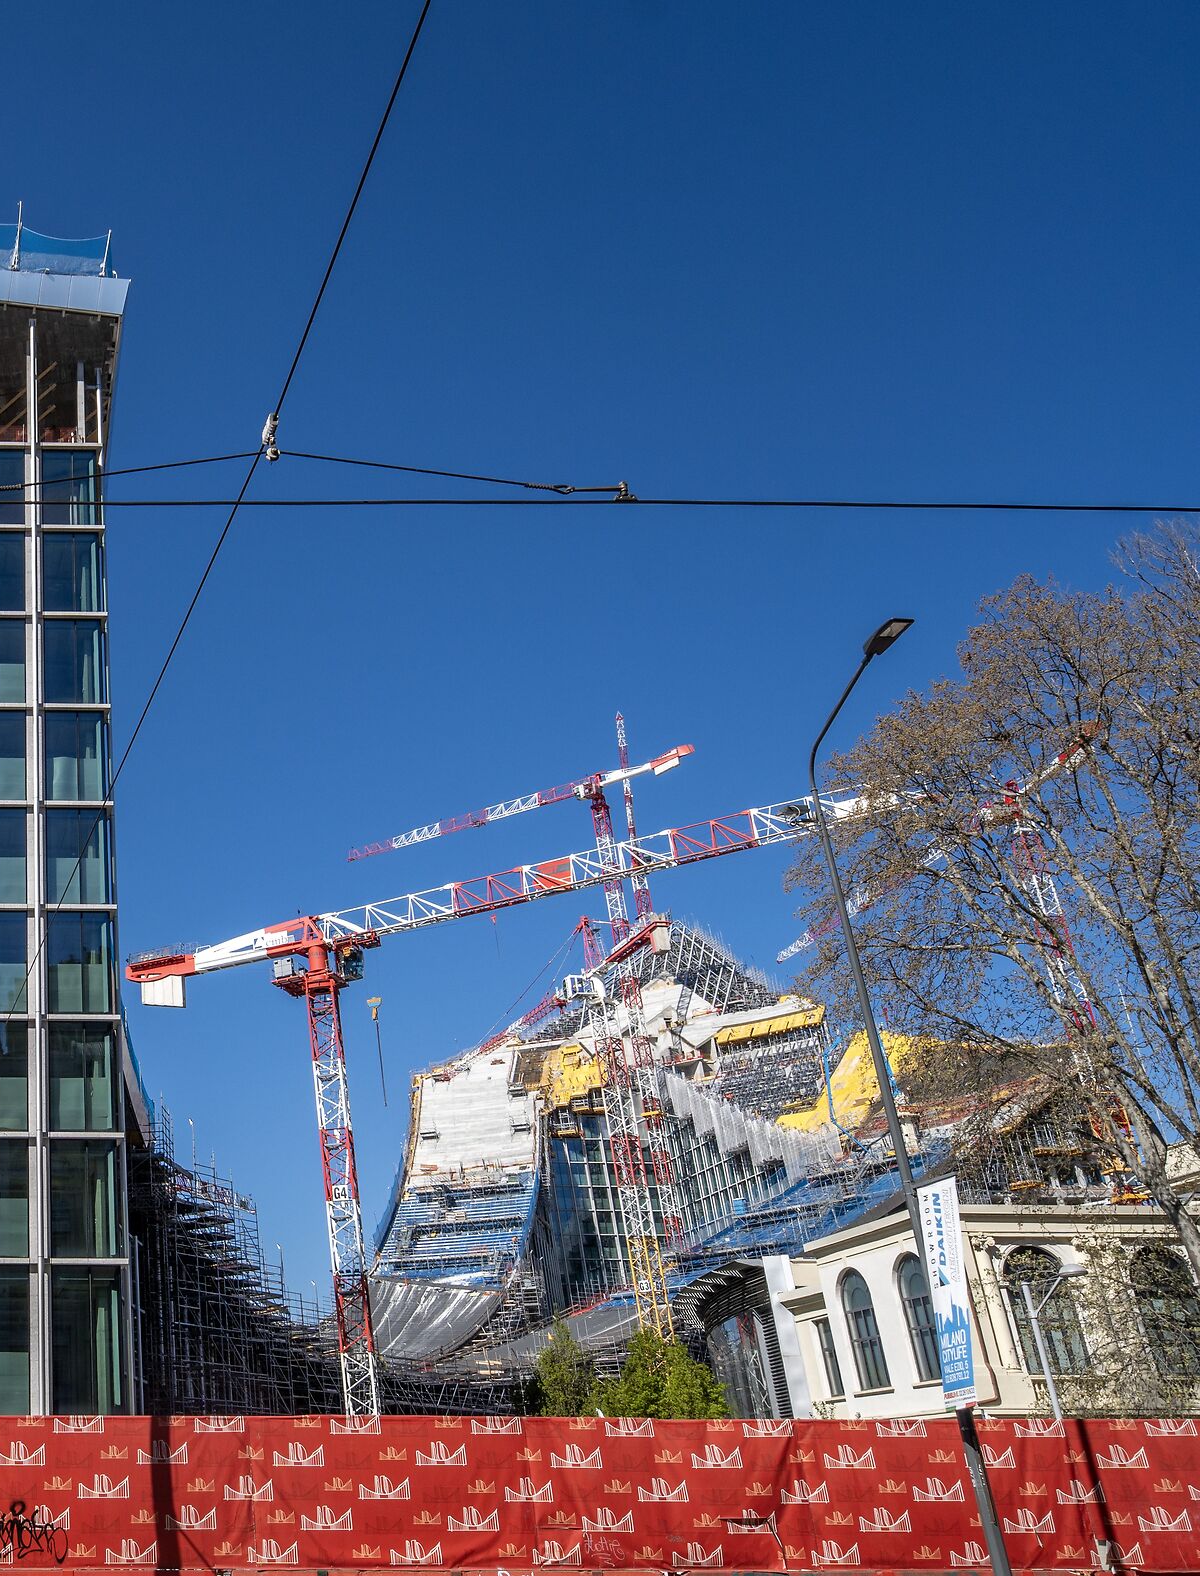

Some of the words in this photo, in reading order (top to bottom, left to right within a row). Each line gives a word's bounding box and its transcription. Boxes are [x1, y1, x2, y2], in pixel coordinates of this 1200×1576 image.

[333, 1187, 347, 1199] G4
[931, 1193, 947, 1267] DAIKIN
[922, 1194, 939, 1290] SHOWROOM
[940, 1329, 966, 1349] MILANO
[942, 1345, 968, 1363] CITYLIFE
